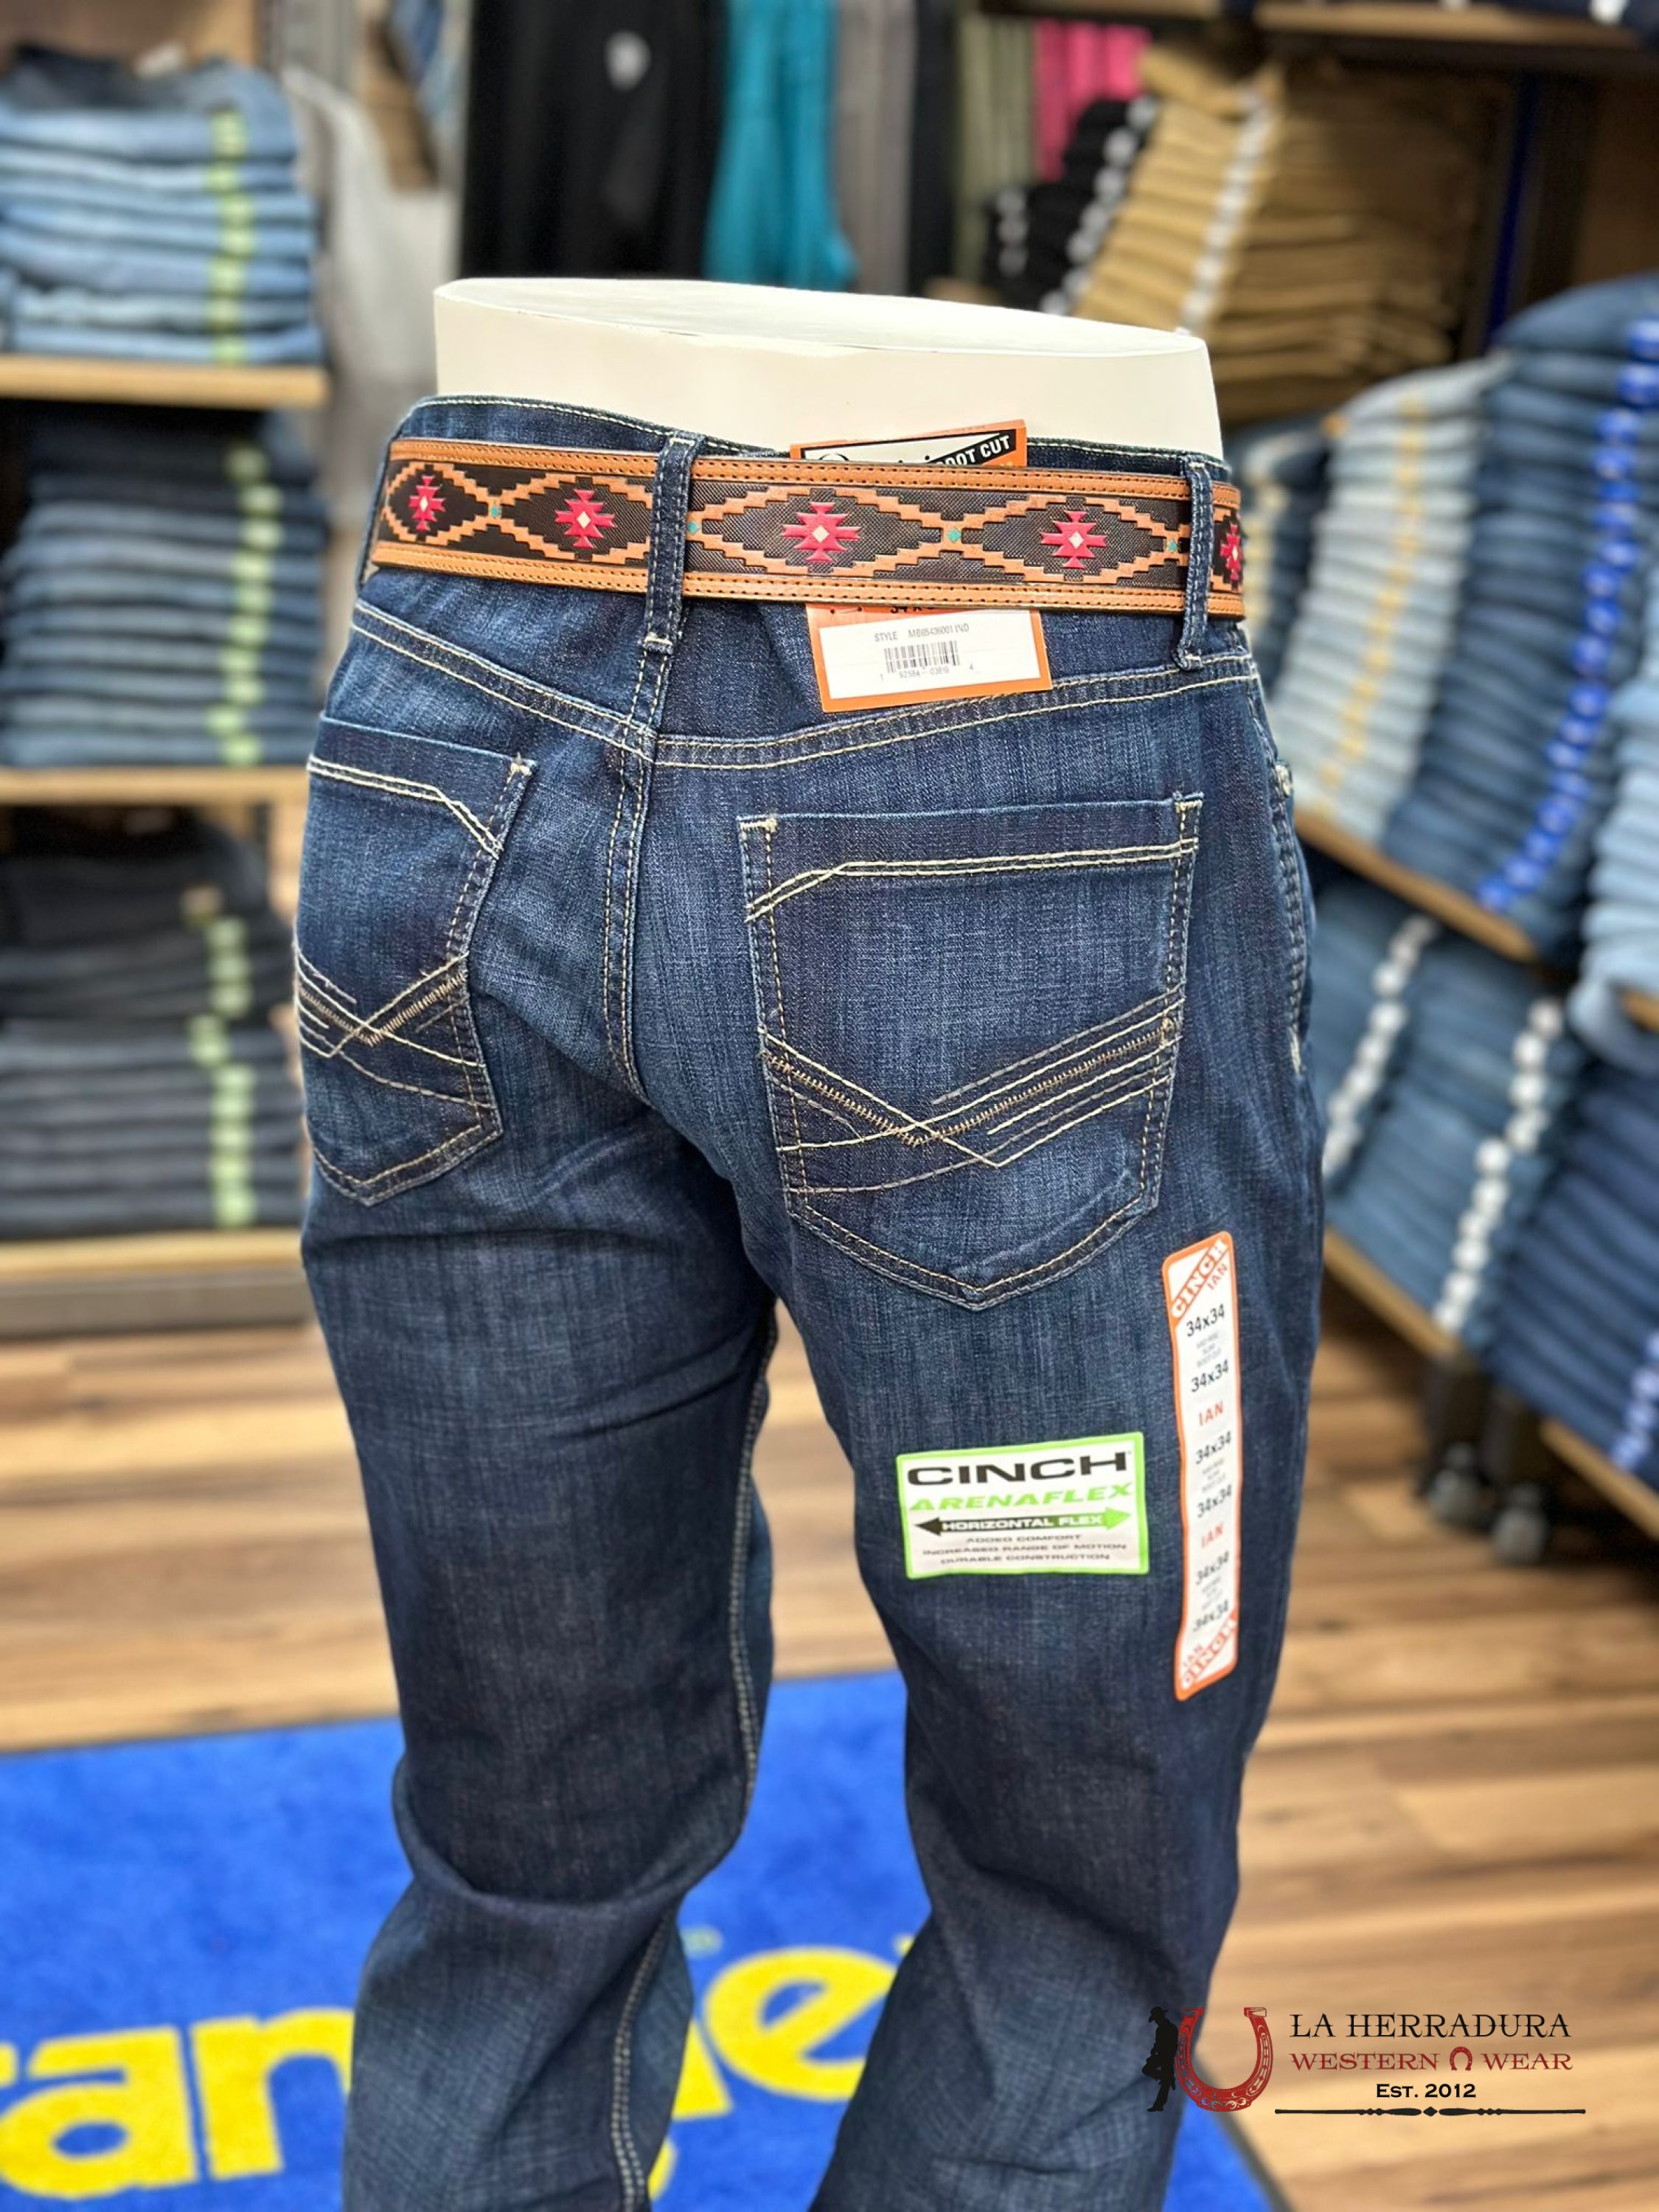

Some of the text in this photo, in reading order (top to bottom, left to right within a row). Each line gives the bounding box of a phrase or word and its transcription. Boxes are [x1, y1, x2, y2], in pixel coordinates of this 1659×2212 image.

[980, 435, 1009, 457] CUT
[874, 632, 897, 641] STYLE
[1171, 1239, 1228, 1318] CINCH
[1207, 1263, 1228, 1290] IAN
[1186, 1303, 1225, 1337] 34x34
[1191, 1359, 1229, 1393] 34x34
[1198, 1402, 1224, 1427] IAN
[1195, 1430, 1232, 1465] 34x34
[907, 1452, 1127, 1486] CINCH
[909, 1482, 1133, 1512] ARENAFLEX
[1197, 1484, 1231, 1518] 34x34
[942, 1514, 1104, 1531] HORIZONTAL FLEX
[1200, 1523, 1224, 1548] IAN
[922, 1546, 999, 1556] INCREASED
[1016, 1534, 1082, 1543] COMFORT
[940, 1556, 1002, 1565] DURABLE
